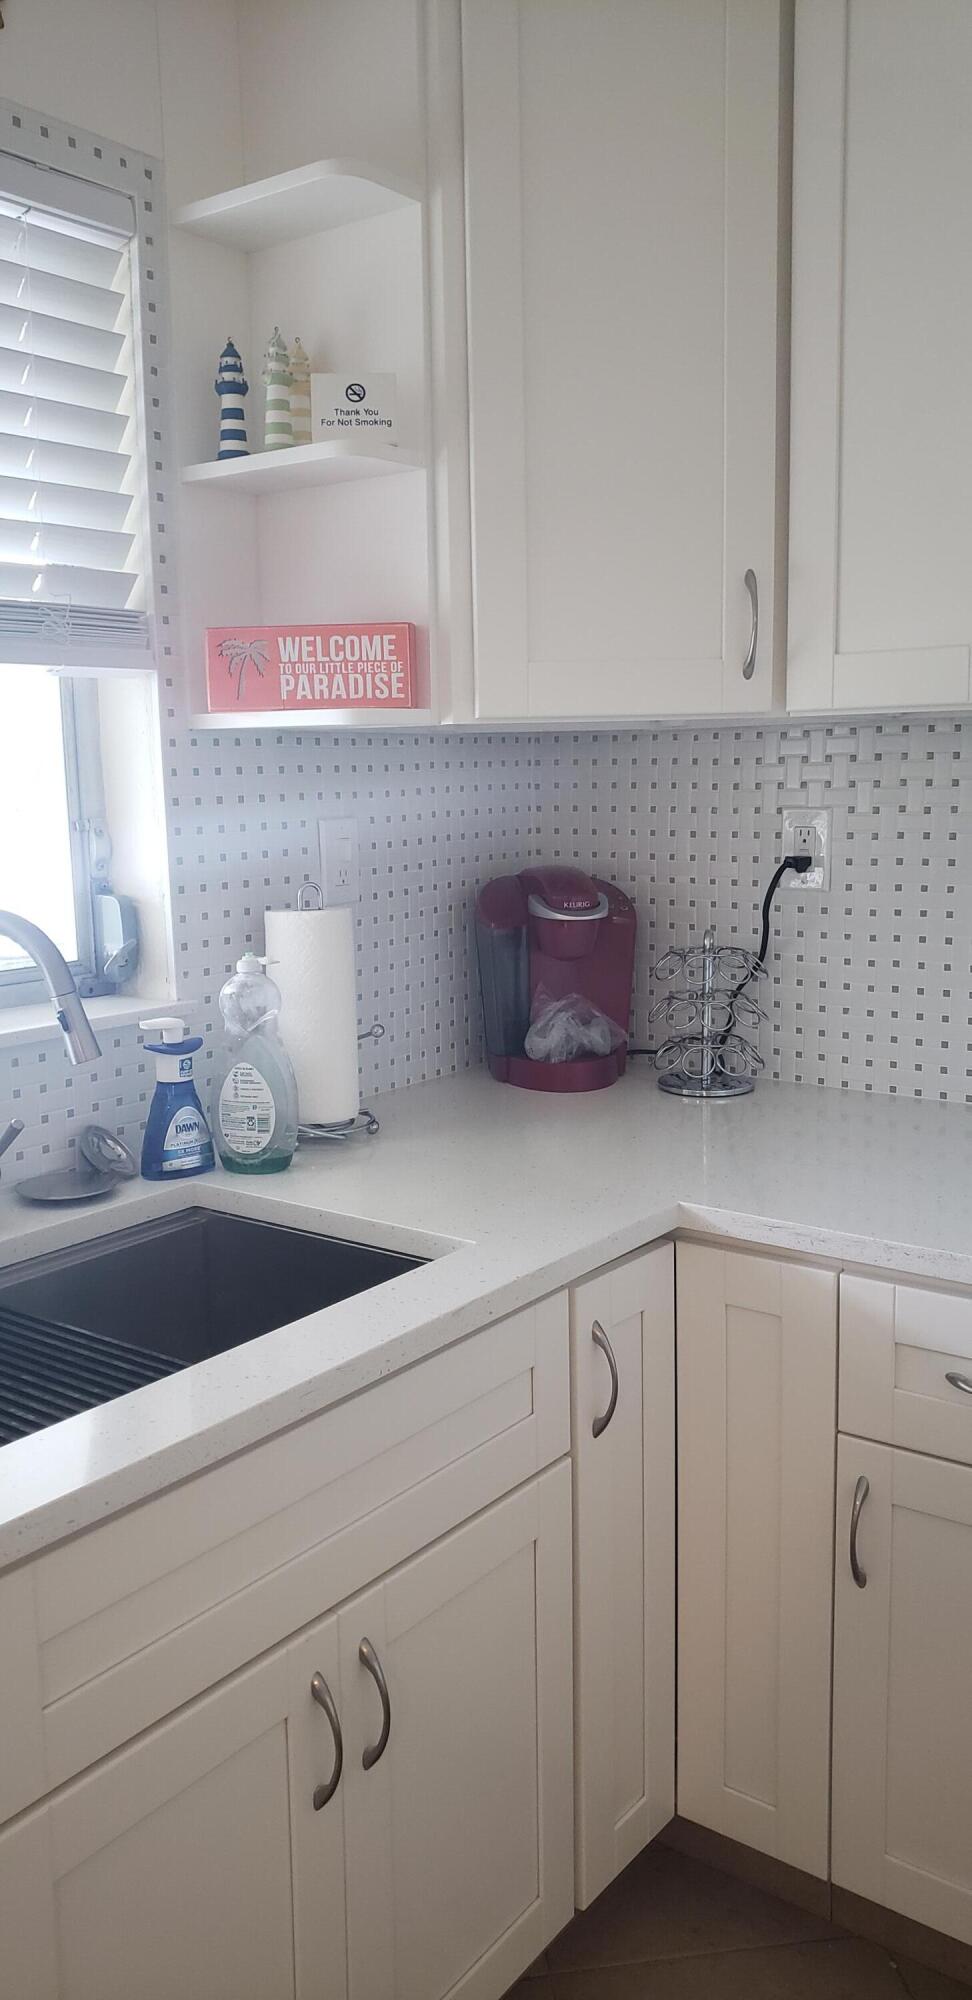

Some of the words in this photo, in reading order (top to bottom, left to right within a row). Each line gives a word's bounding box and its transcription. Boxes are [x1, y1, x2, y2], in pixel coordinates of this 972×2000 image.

[334, 408, 360, 416] Thank
[363, 408, 379, 416] You
[355, 418, 392, 427] Smoking
[277, 634, 397, 662] WELCOME
[279, 663, 292, 674] TO
[295, 663, 316, 674] OUR
[320, 662, 354, 674] LITTLE
[358, 662, 386, 673] PIECE
[390, 661, 403, 673] OF
[280, 672, 405, 700] PARADISE
[175, 1121, 200, 1135] DAWN
